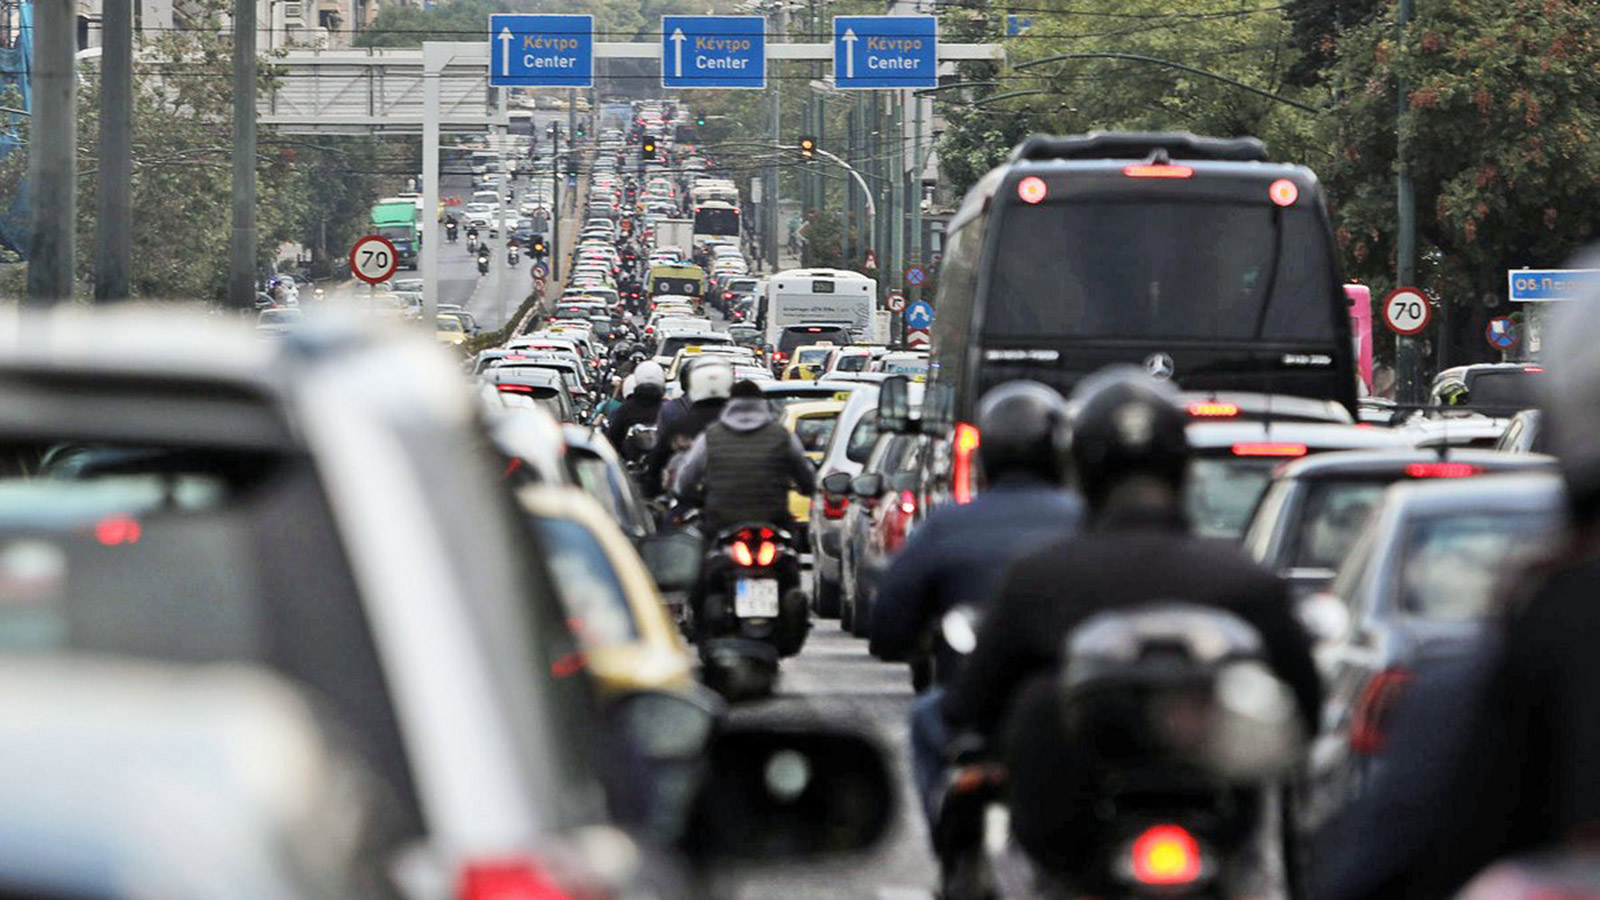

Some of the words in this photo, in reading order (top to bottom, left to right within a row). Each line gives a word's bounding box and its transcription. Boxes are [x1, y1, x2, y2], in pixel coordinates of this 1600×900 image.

[523, 34, 578, 52] Κέντρο
[695, 35, 751, 53] Κέντρο
[867, 35, 923, 53] Κέντρο
[523, 54, 577, 68] Center
[696, 55, 750, 69] Center
[868, 55, 921, 69] Center
[362, 250, 388, 269] 70
[1394, 302, 1421, 320] 70
